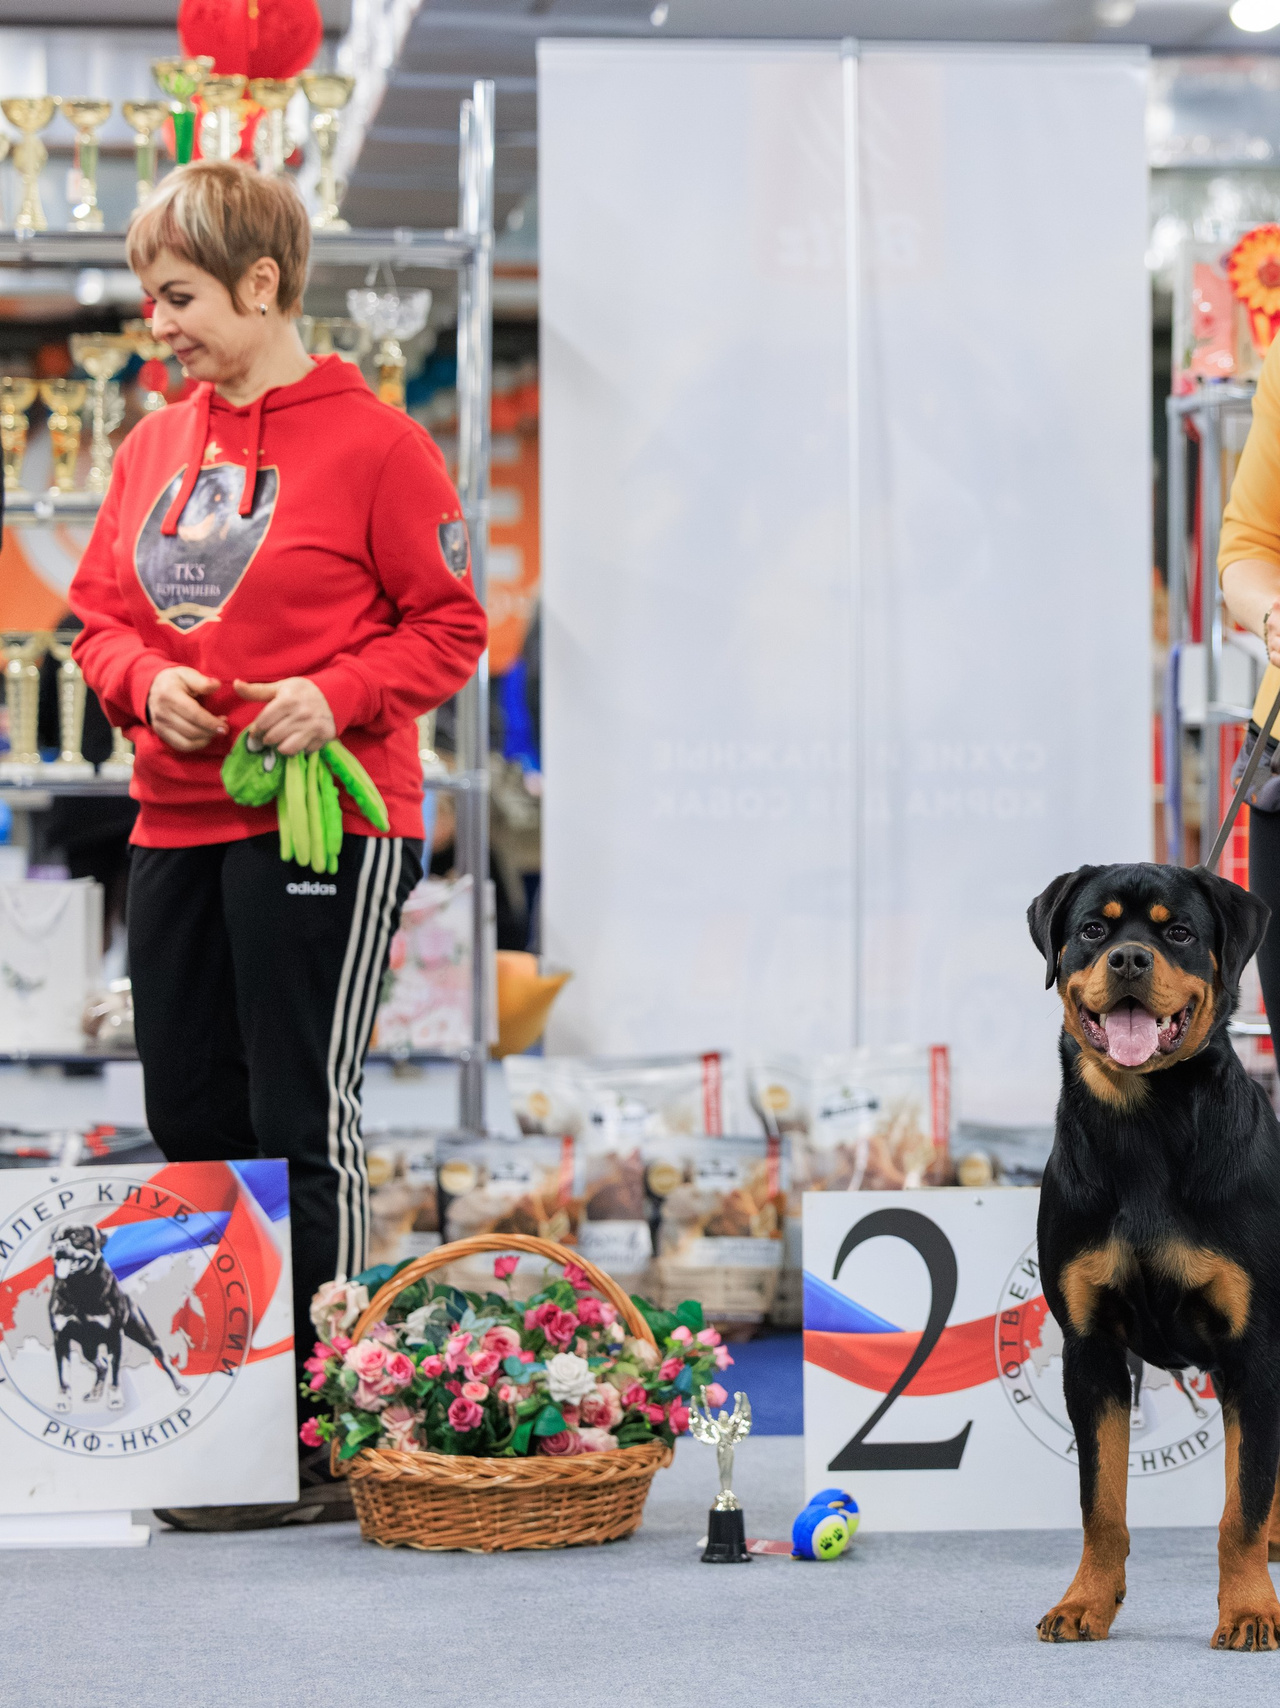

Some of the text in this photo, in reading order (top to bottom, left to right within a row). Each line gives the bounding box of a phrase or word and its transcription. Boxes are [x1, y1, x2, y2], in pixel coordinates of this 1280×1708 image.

[286, 881, 338, 896] adidas
[99, 1183, 190, 1224] КЛУБ
[202, 1229, 249, 1378] РОССИИ
[827, 1208, 974, 1472] 2
[1000, 1256, 1040, 1405] РОТВЕЙ
[43, 1408, 193, 1452] РКФ-НКПР
